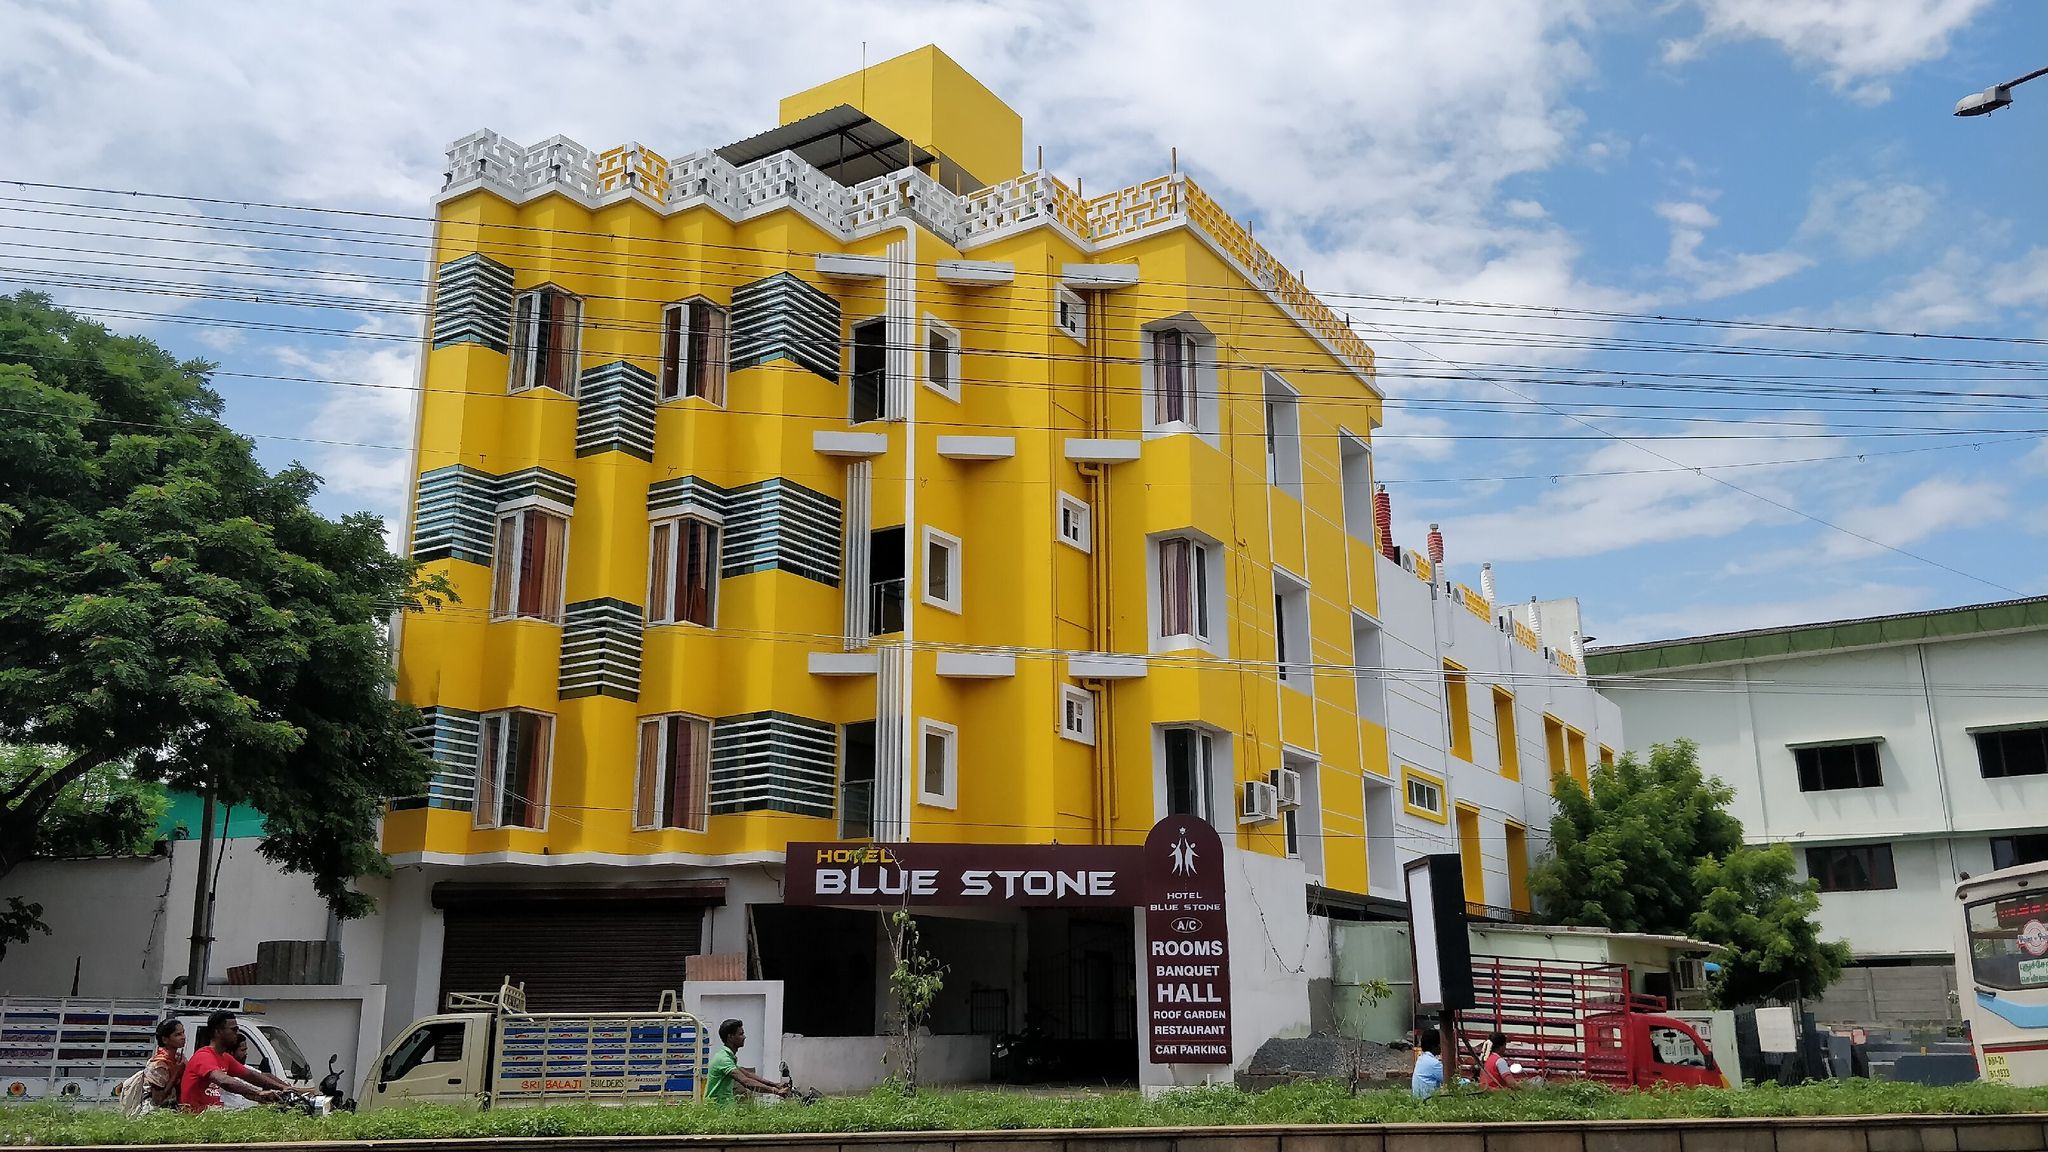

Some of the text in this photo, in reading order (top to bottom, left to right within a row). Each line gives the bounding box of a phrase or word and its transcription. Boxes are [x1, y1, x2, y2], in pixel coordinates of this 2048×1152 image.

[815, 866, 1117, 900] BLUE STONE
[1167, 892, 1203, 900] HOTEL
[1183, 903, 1221, 911] STONE
[1177, 920, 1197, 931] A/C
[1152, 940, 1223, 956] ROOMS
[1156, 965, 1220, 977] BANQUET
[1157, 983, 1222, 1003] HALL
[1153, 1010, 1226, 1019] ROOF GARDEN
[1154, 1025, 1226, 1035] RESTAURANT
[1155, 1045, 1227, 1054] CAR PARKING
[521, 1080, 540, 1089] SRI
[545, 1079, 582, 1089] BALAJI
[590, 1079, 624, 1088] BUILDERS
